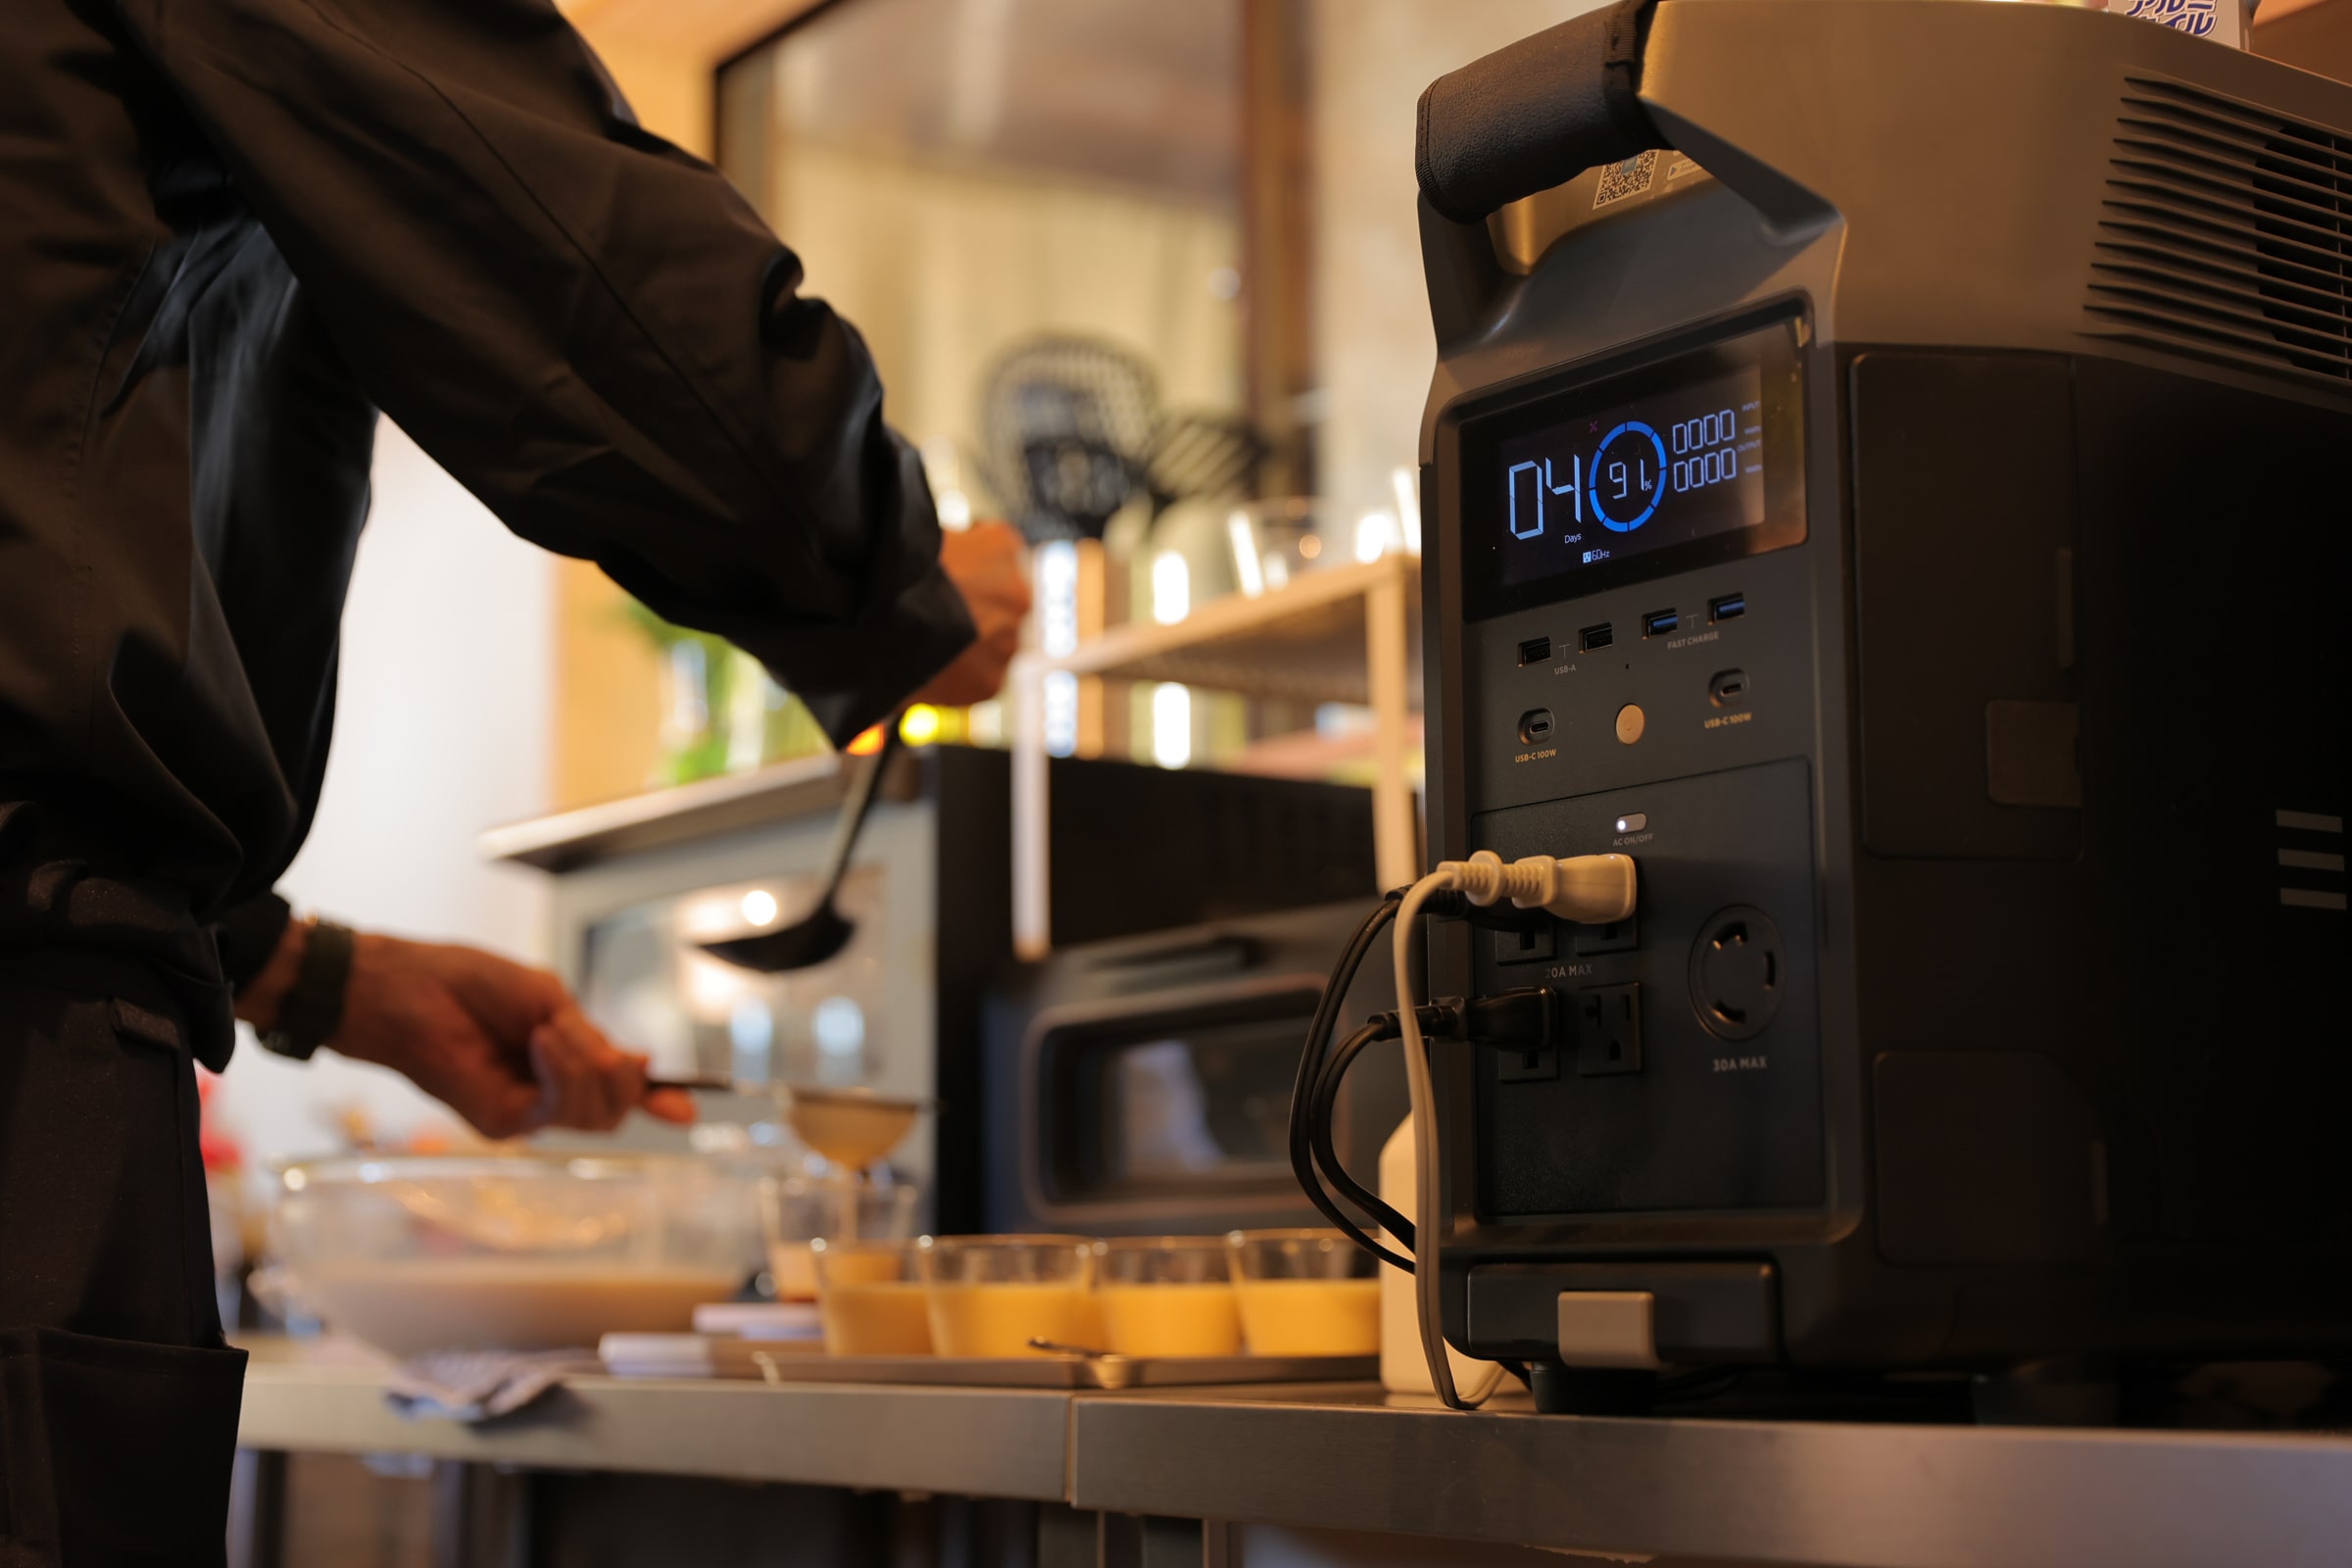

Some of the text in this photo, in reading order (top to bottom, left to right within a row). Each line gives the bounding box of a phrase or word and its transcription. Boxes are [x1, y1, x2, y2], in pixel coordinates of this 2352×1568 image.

[1672, 409, 1735, 455] 0000
[1674, 447, 1737, 493] 0000
[1509, 454, 1581, 539] 04
[1564, 533, 1582, 544] Days
[1592, 549, 1610, 561] 60Hz
[1667, 630, 1719, 650] FAST CHARGE
[1554, 663, 1576, 675] USB-A
[1704, 712, 1752, 729] USB-C 100W
[1515, 749, 1556, 762] USB-C 100W
[1613, 833, 1655, 847] AC ON/OFF
[1545, 964, 1592, 978] 20A MAX
[1713, 1055, 1767, 1072] 30A MAX
